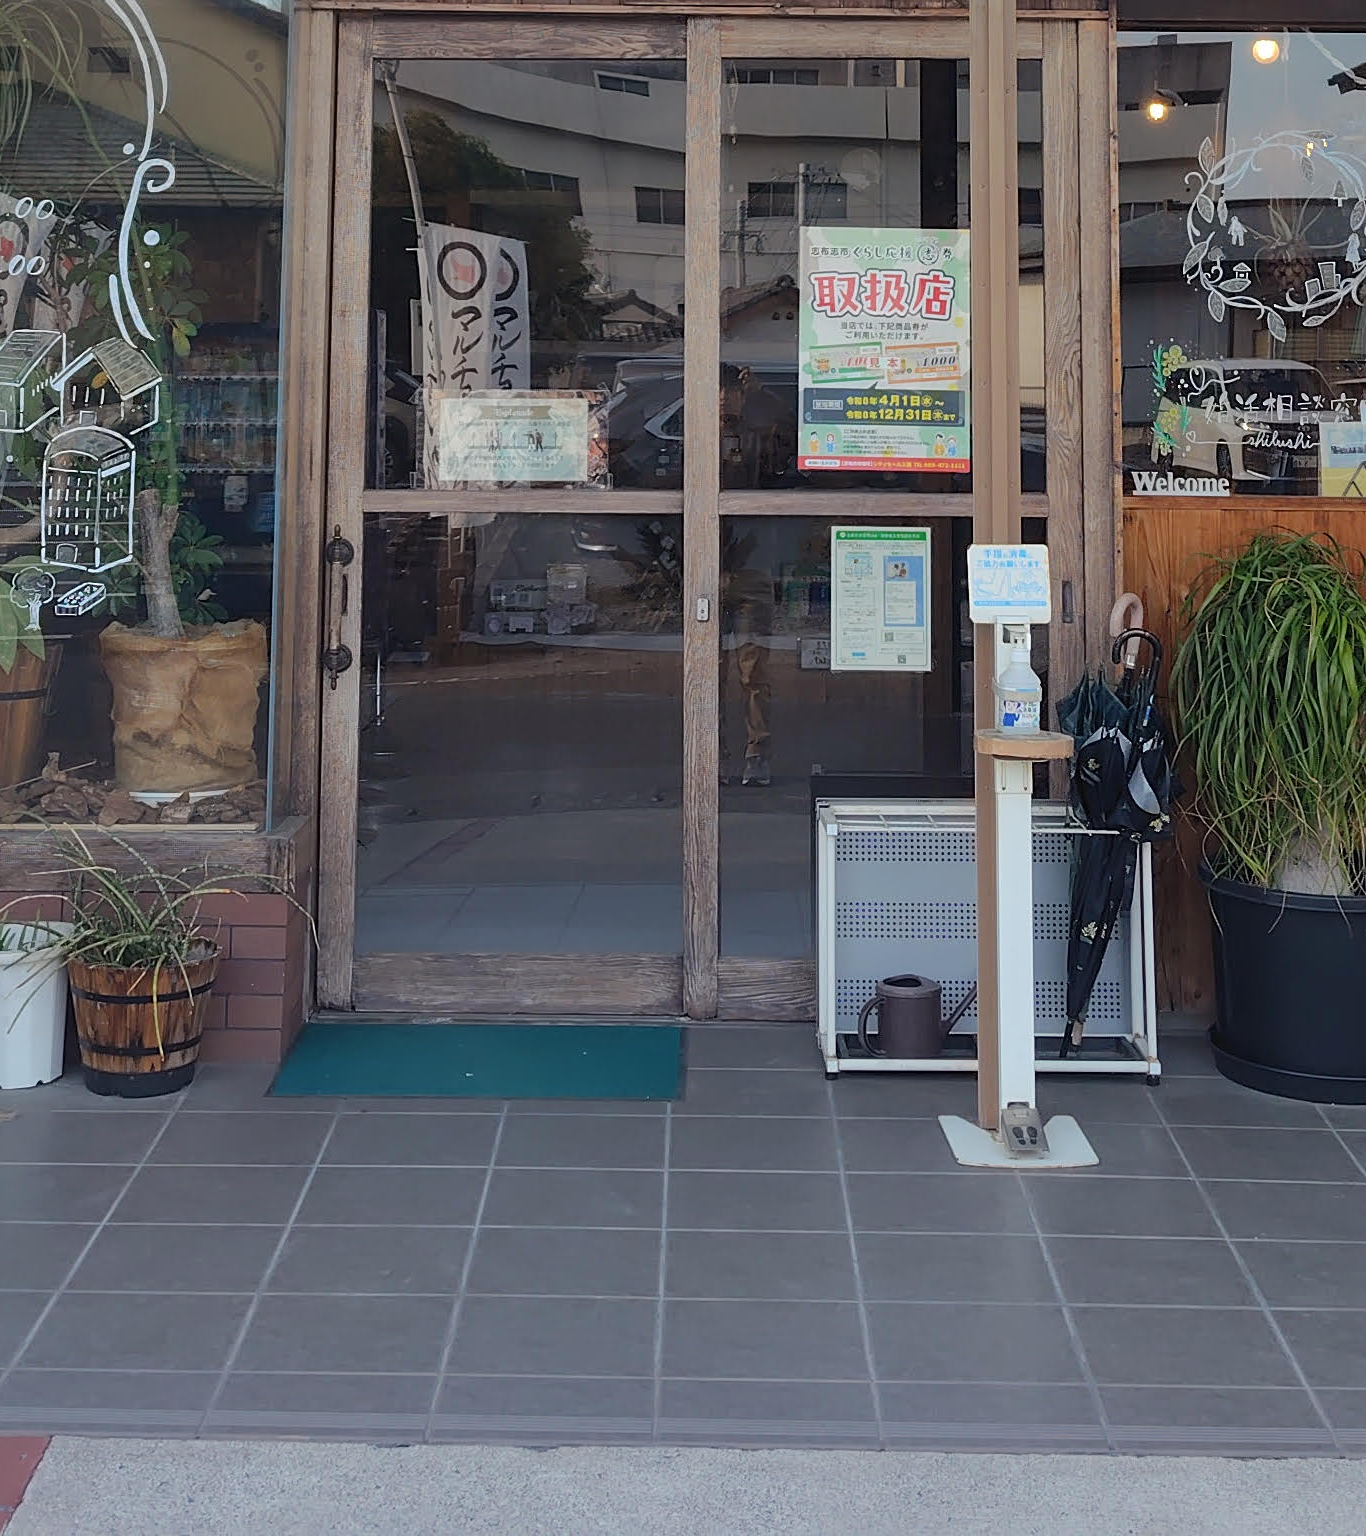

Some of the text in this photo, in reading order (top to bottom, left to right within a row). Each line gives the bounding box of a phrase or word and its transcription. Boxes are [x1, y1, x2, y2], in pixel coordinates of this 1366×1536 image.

[813, 272, 952, 317] 取扱店
[1131, 471, 1230, 494] Welcome
